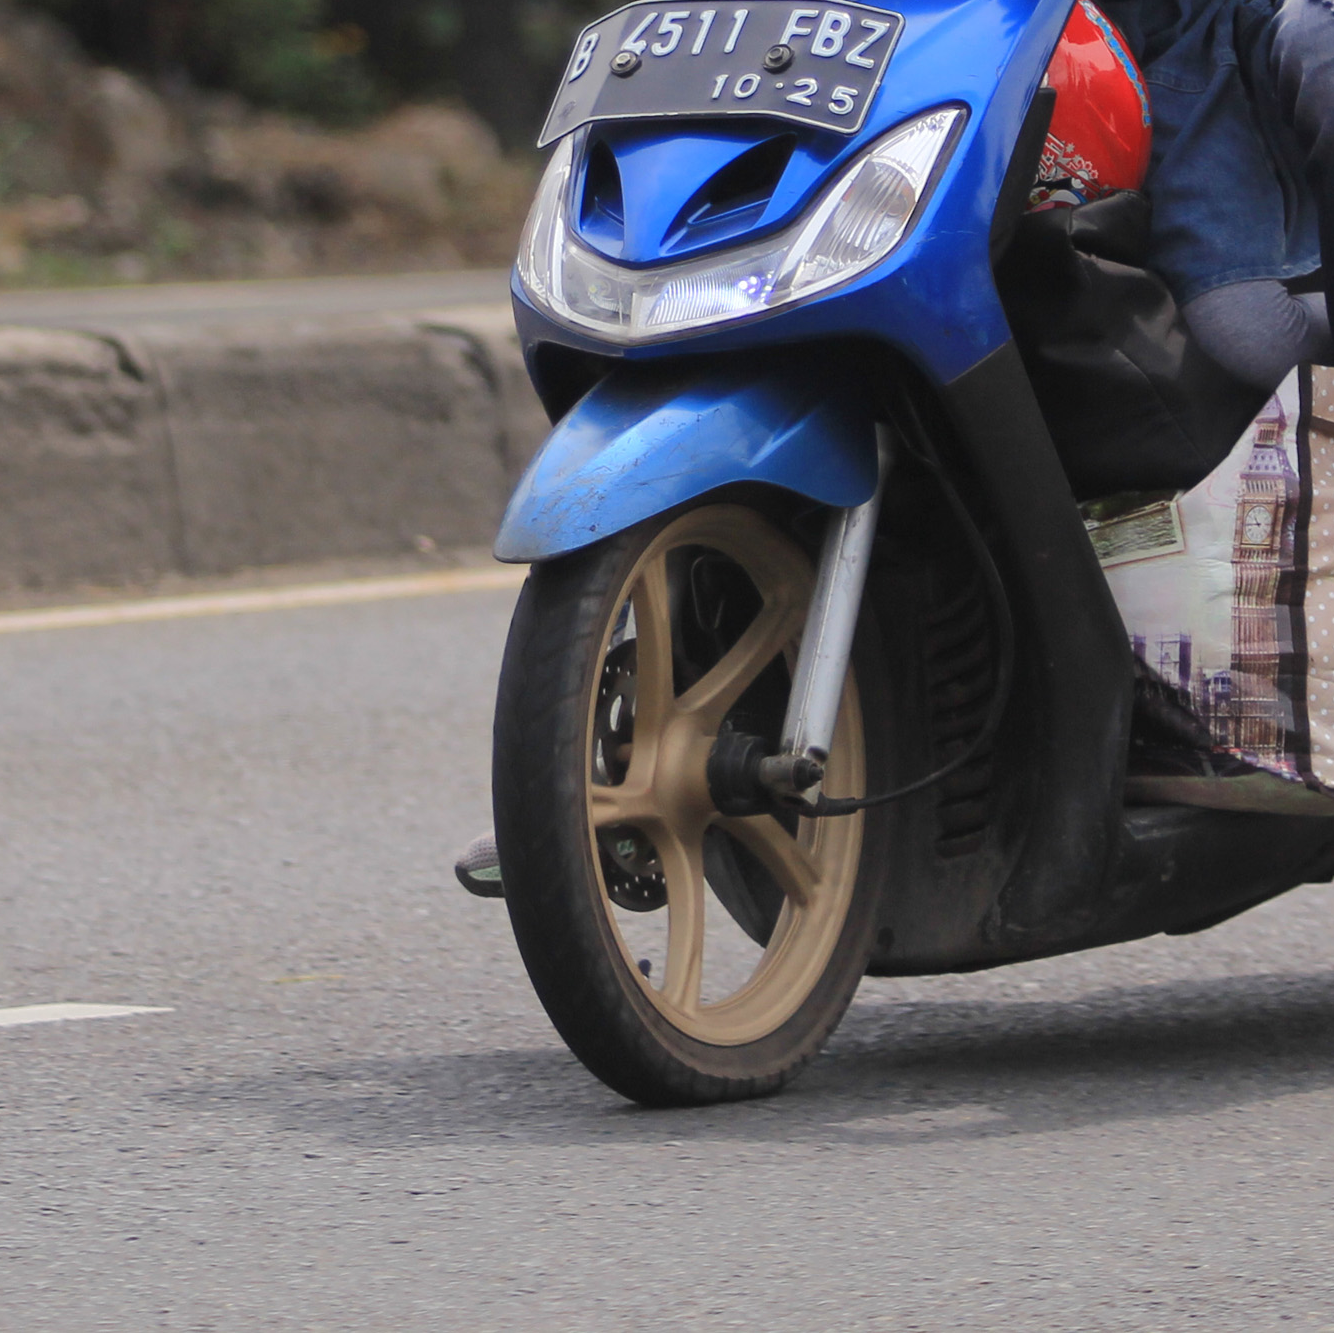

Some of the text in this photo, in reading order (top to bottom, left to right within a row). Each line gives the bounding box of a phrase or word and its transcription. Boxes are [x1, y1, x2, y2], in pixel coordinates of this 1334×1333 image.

[569, 9, 890, 82] B 4511 FBZ
